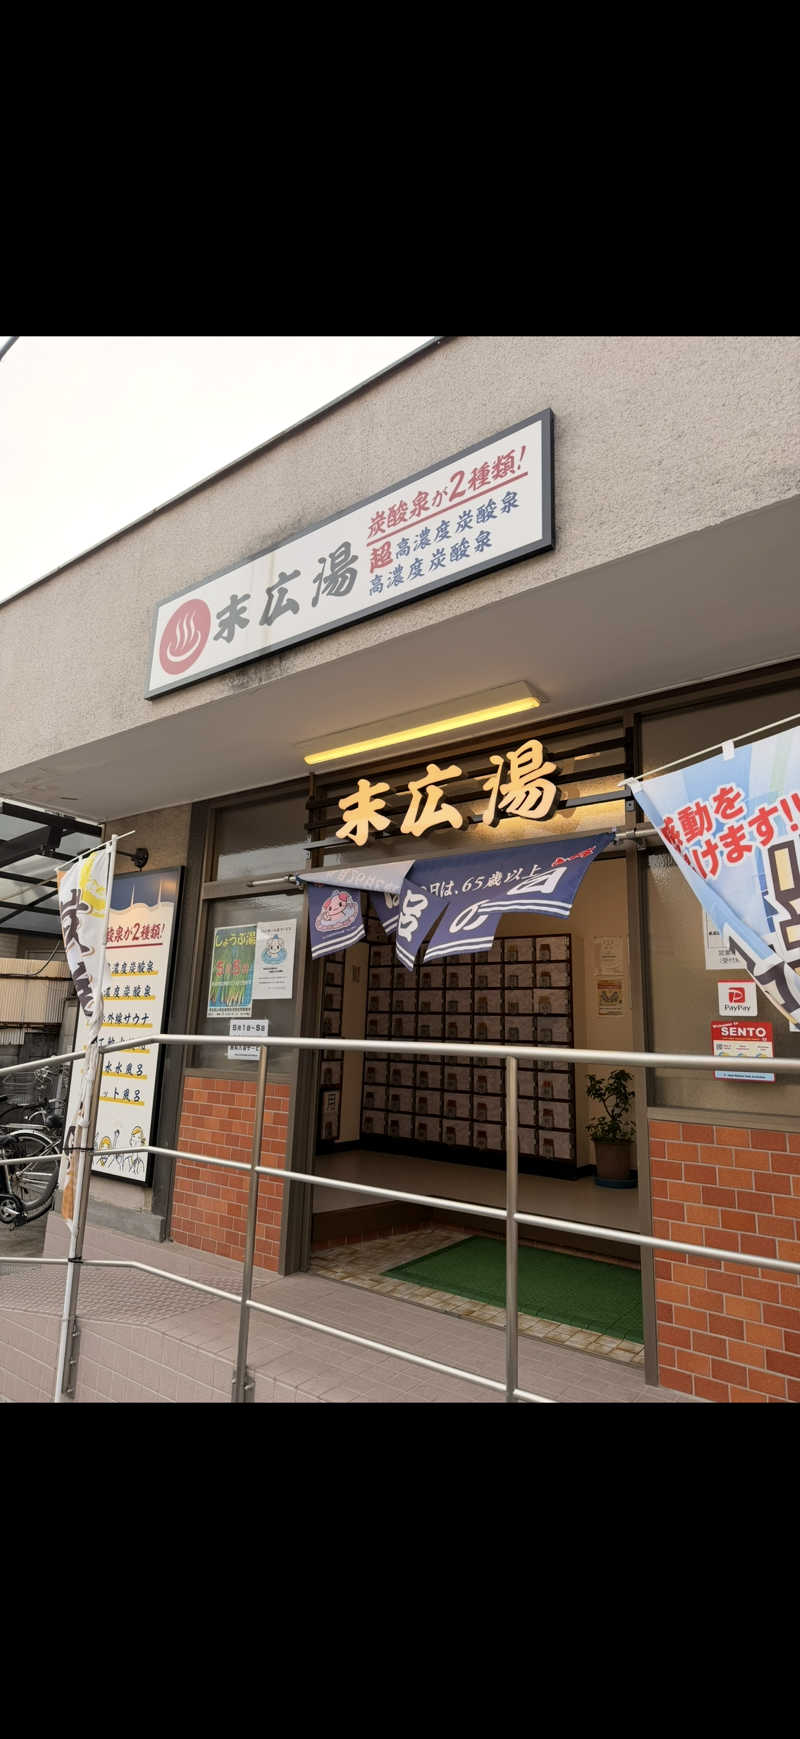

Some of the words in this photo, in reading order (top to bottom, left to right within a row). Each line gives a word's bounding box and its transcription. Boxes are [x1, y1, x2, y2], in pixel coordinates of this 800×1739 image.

[369, 445, 528, 538] 炭酸泉が2種類!
[370, 490, 520, 573] 超高濃度炭酸泉
[213, 541, 360, 644] 末広湯
[369, 530, 493, 597] 高濃度炭酸泉
[335, 739, 557, 847] 末広湯
[720, 1027, 767, 1038] SENTO
[724, 1003, 751, 1013] PayPay
